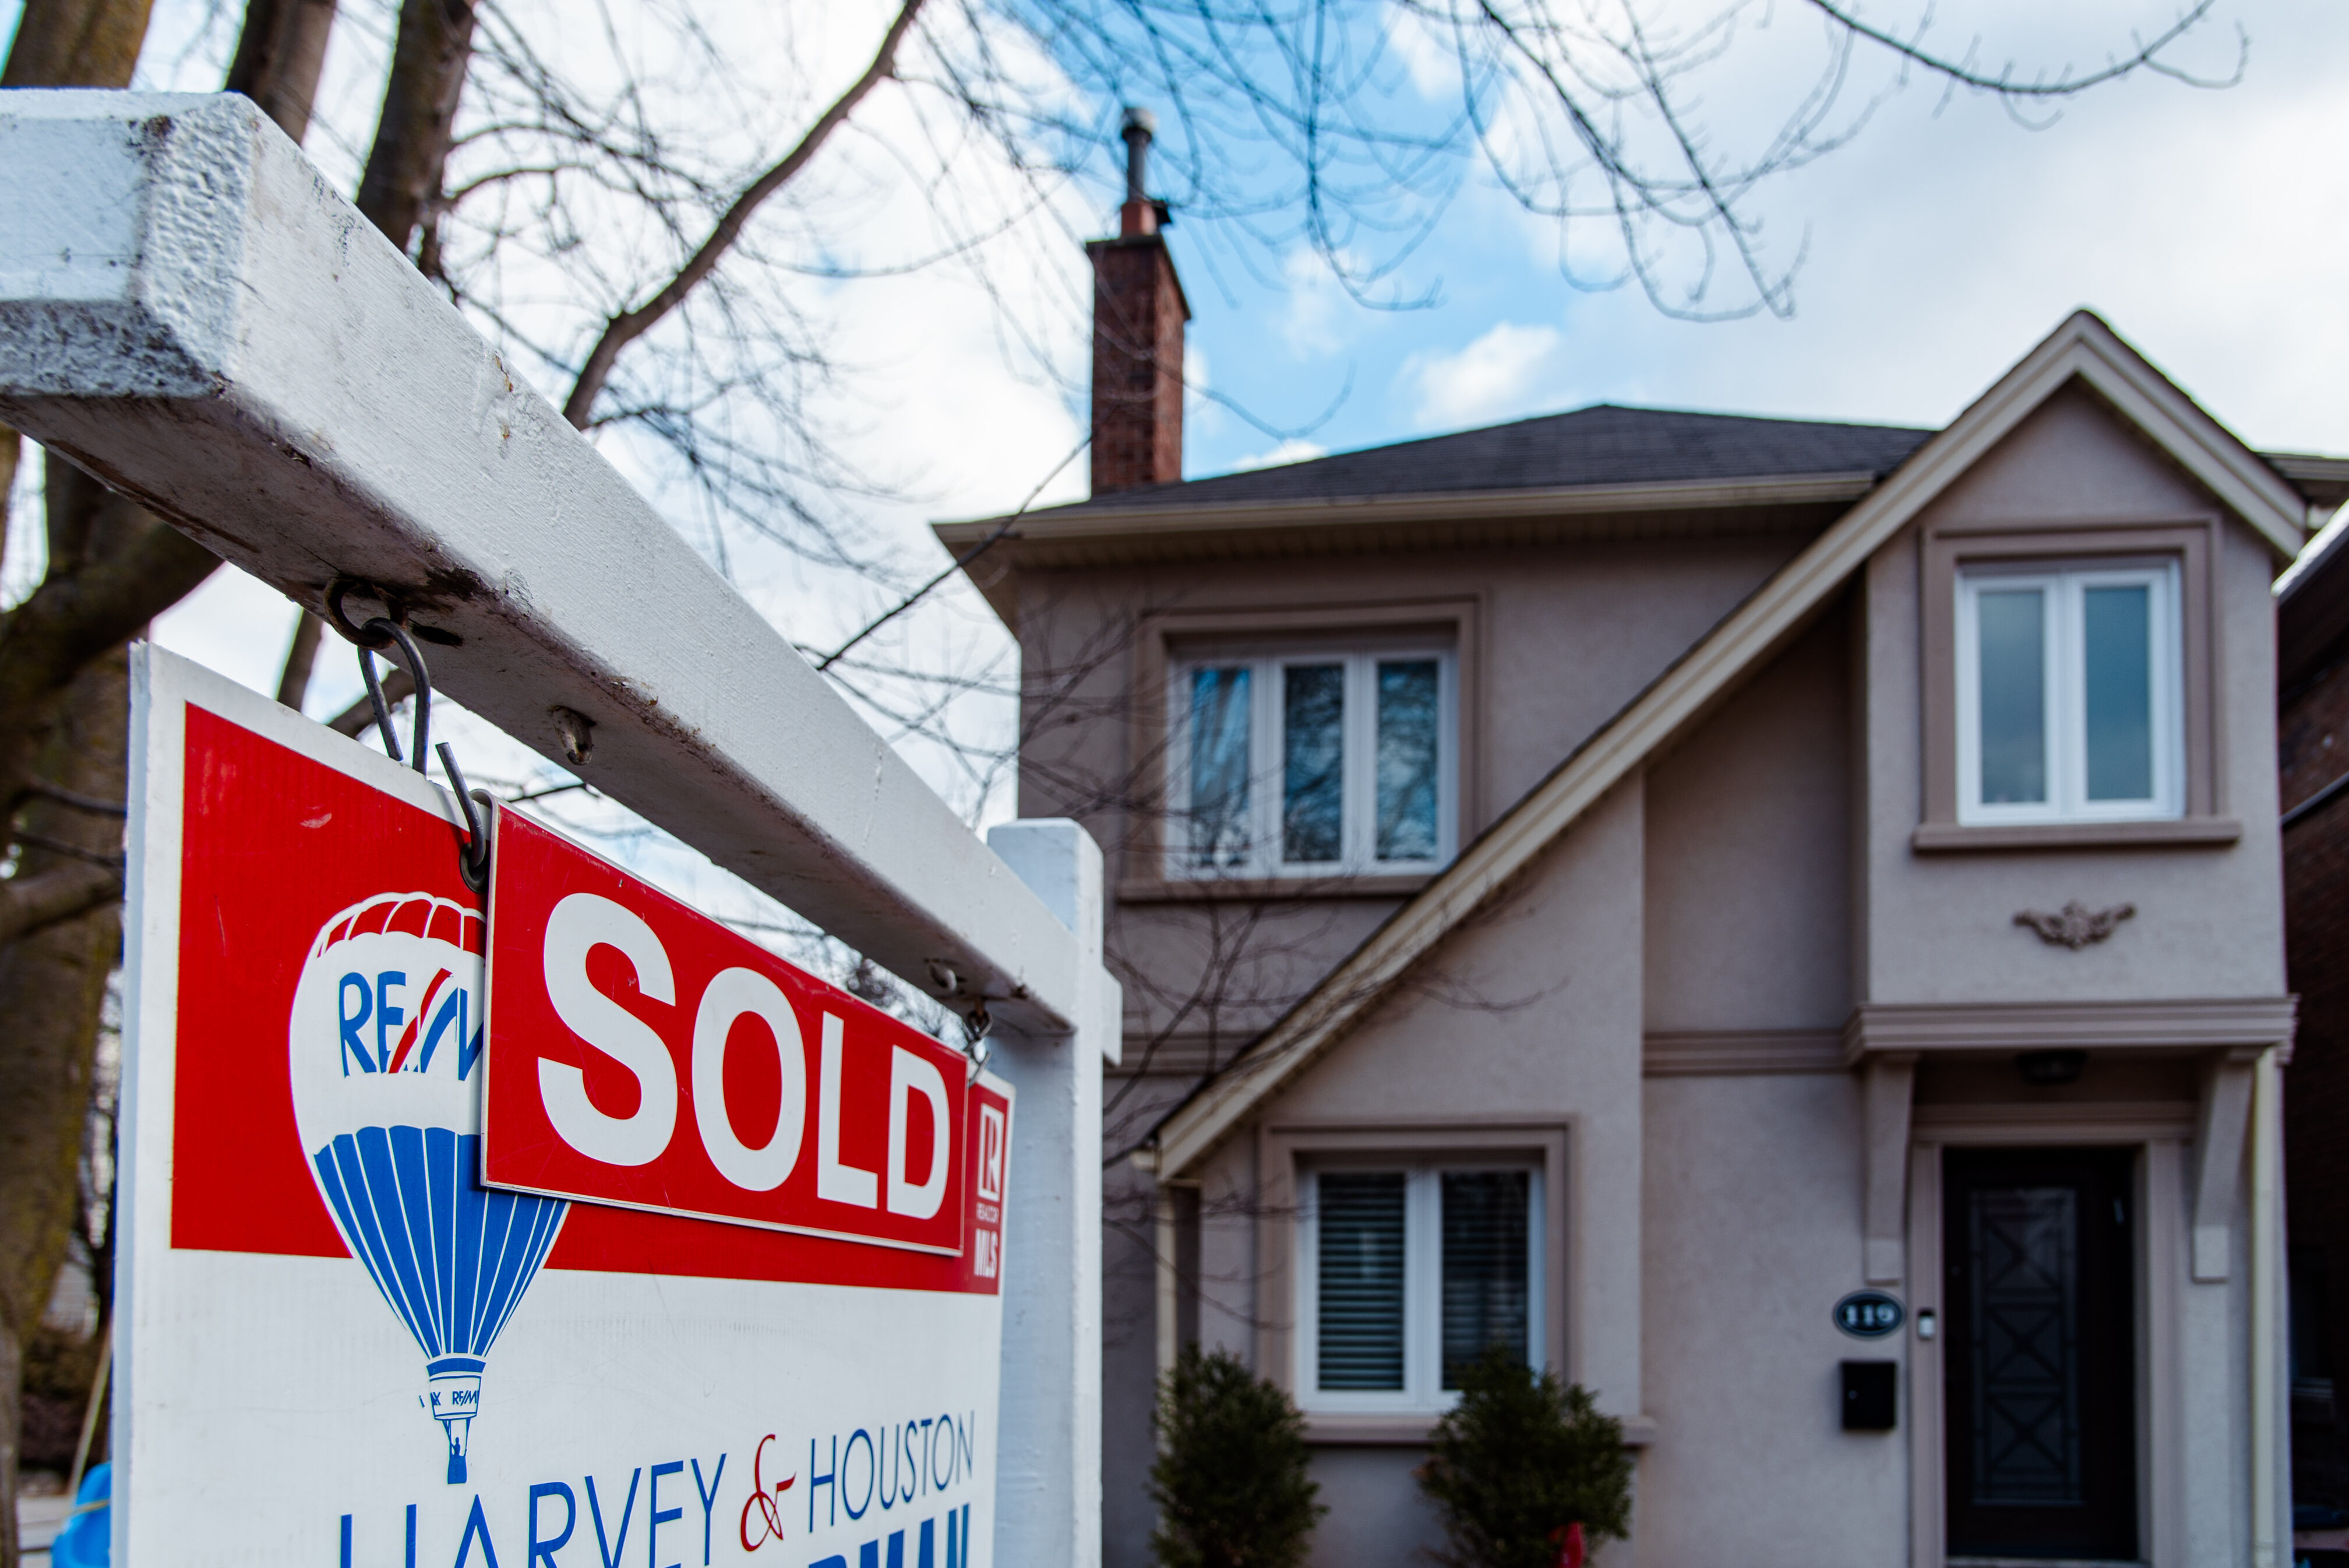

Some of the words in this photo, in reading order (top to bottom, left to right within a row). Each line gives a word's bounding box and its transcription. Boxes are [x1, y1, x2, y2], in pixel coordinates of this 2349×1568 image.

[538, 892, 950, 1220] SOLD
[974, 1228, 998, 1279] MLS
[1846, 1305, 1895, 1325] 119
[340, 1453, 727, 1568] RVEY
[740, 1434, 796, 1552] &
[809, 1410, 975, 1533] HOUSTON
